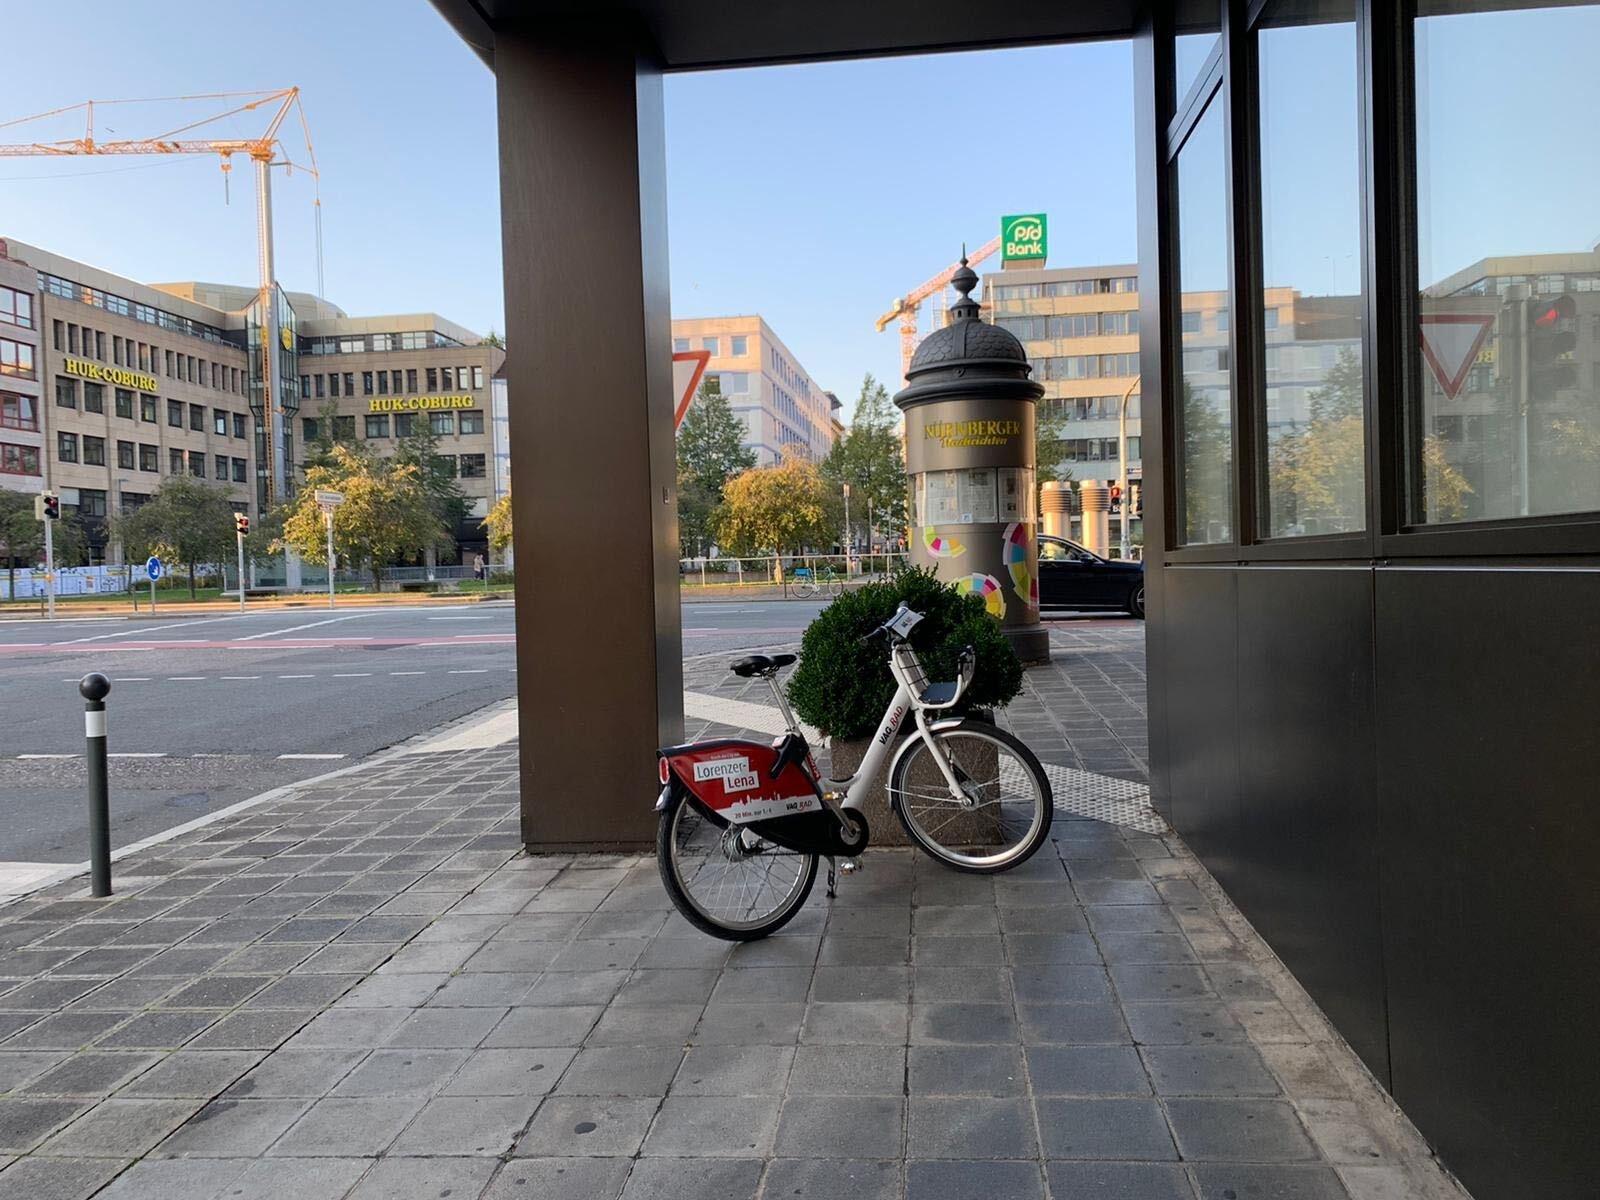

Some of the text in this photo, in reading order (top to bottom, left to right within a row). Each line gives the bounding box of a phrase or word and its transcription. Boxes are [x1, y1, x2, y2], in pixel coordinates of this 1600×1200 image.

[1006, 241, 1043, 256] Bank
[65, 357, 158, 392] HUK-COBURG
[368, 394, 475, 412] HUK-COBURG
[879, 705, 904, 745] VAG RAD
[696, 762, 747, 779] Lorenzer-
[727, 775, 755, 789] Lena
[786, 800, 813, 811] VAG RAD
